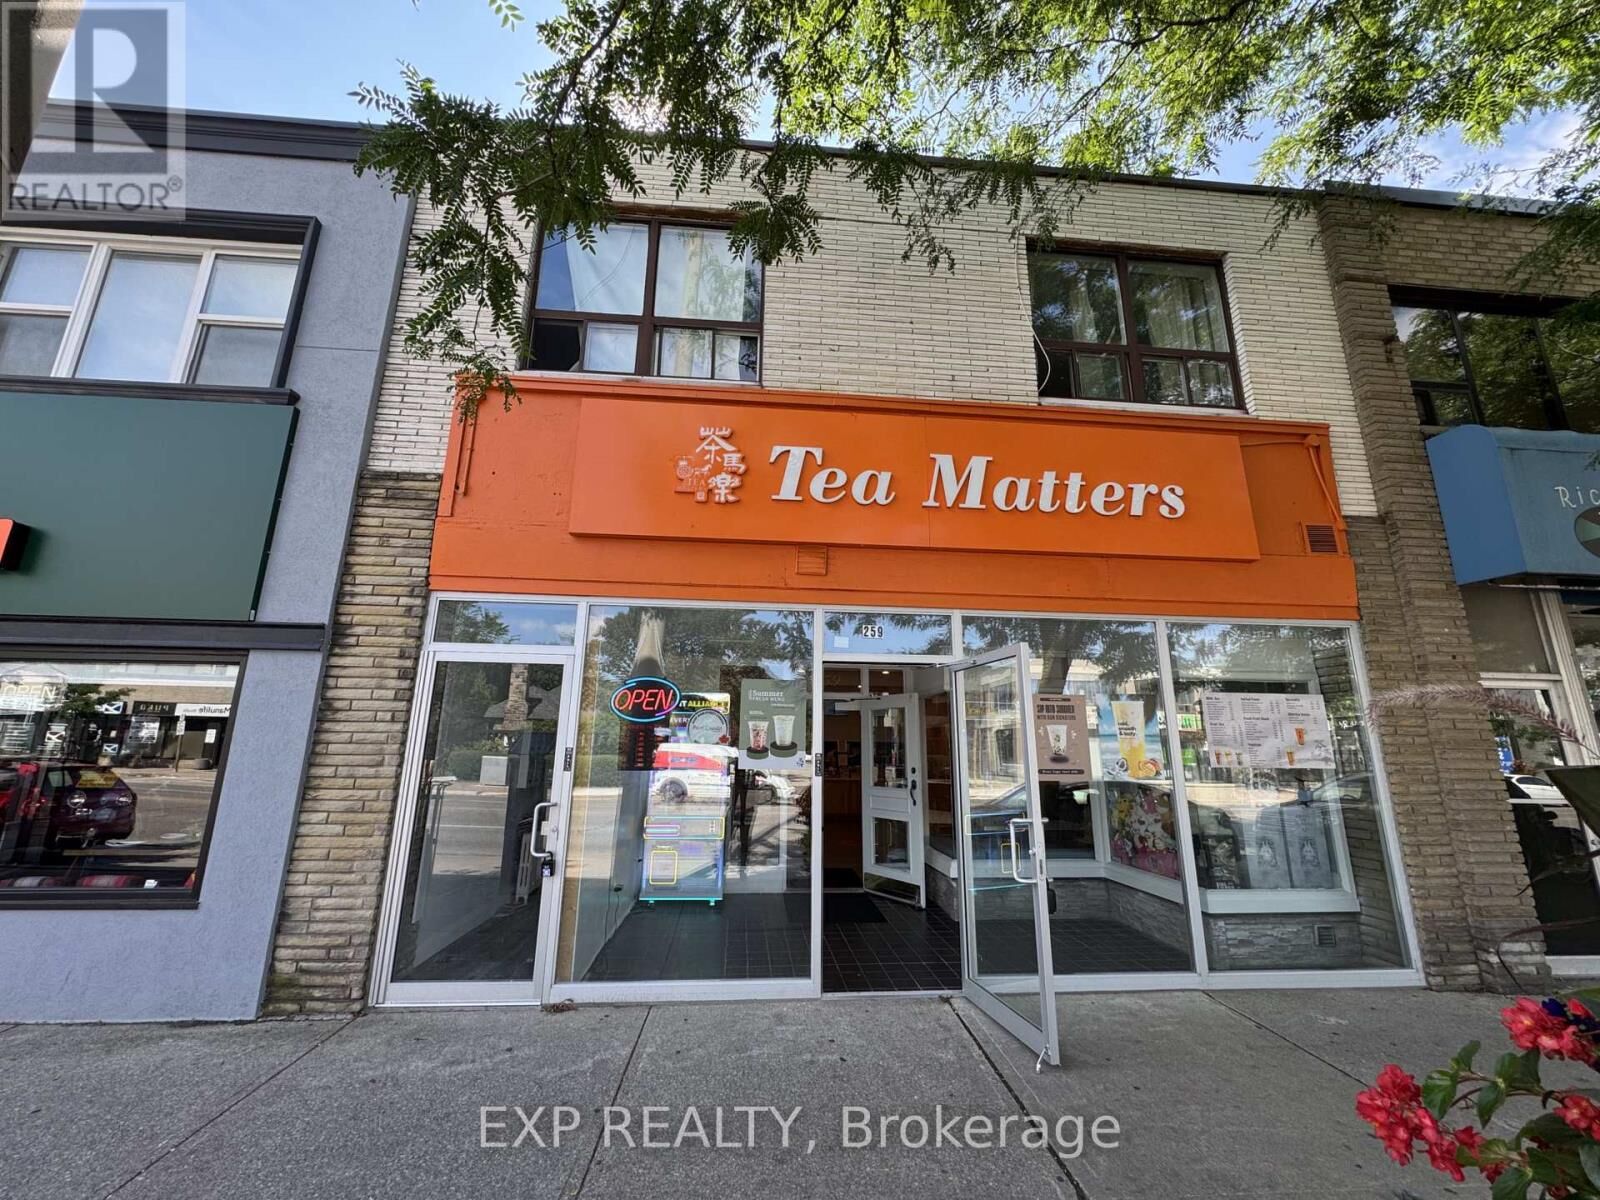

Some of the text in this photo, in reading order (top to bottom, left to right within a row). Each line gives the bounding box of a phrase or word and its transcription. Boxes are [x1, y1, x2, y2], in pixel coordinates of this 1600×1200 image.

[769, 444, 1186, 520] Tea Matters
[863, 625, 884, 638] 259
[614, 688, 674, 711] OPEN
[752, 689, 784, 698] Summer
